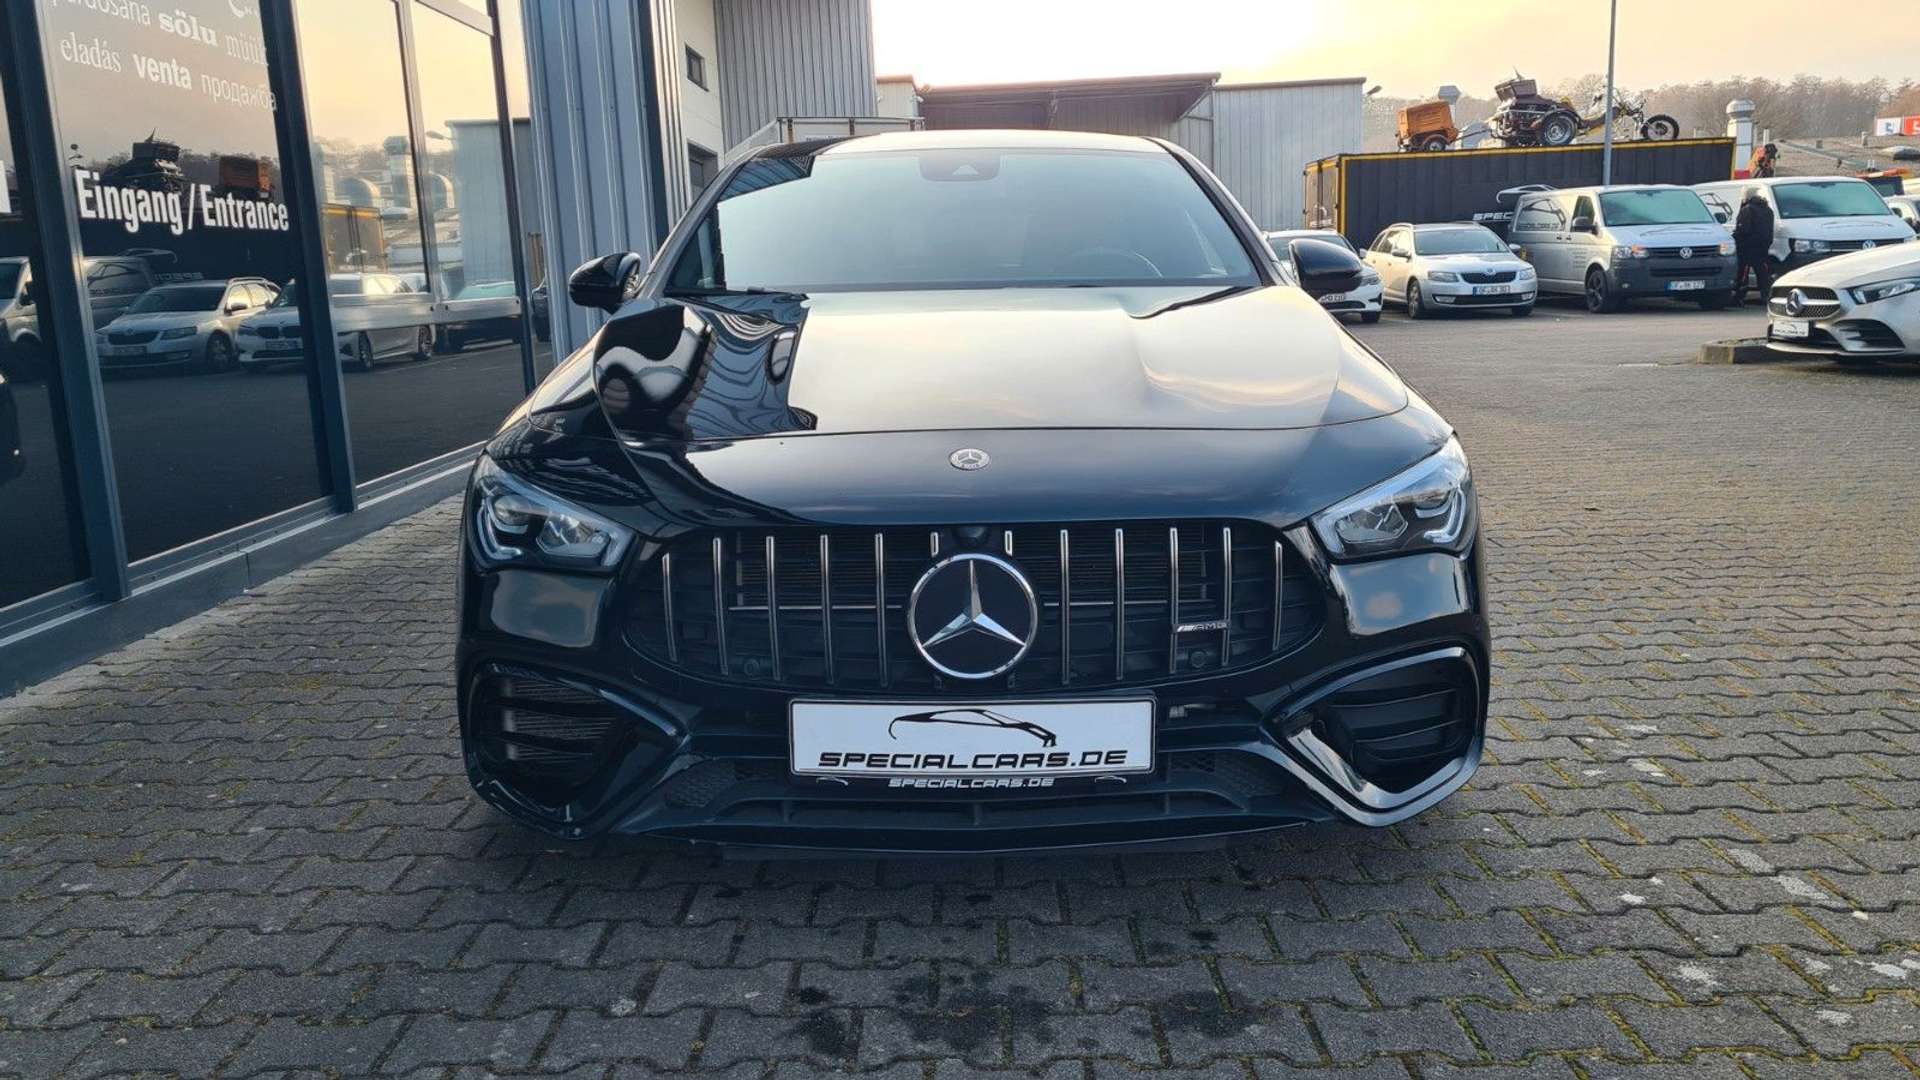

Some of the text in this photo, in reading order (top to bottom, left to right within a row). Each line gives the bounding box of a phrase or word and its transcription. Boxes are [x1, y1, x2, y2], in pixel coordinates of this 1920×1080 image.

[158, 9, 218, 46] sölu
[60, 32, 192, 90] eladás venta
[75, 169, 184, 235] Eingang
[200, 184, 290, 231] Entrance
[818, 750, 1128, 769] SPECIALCARS.DE
[888, 777, 1055, 788] SPECIALCARS.DE
